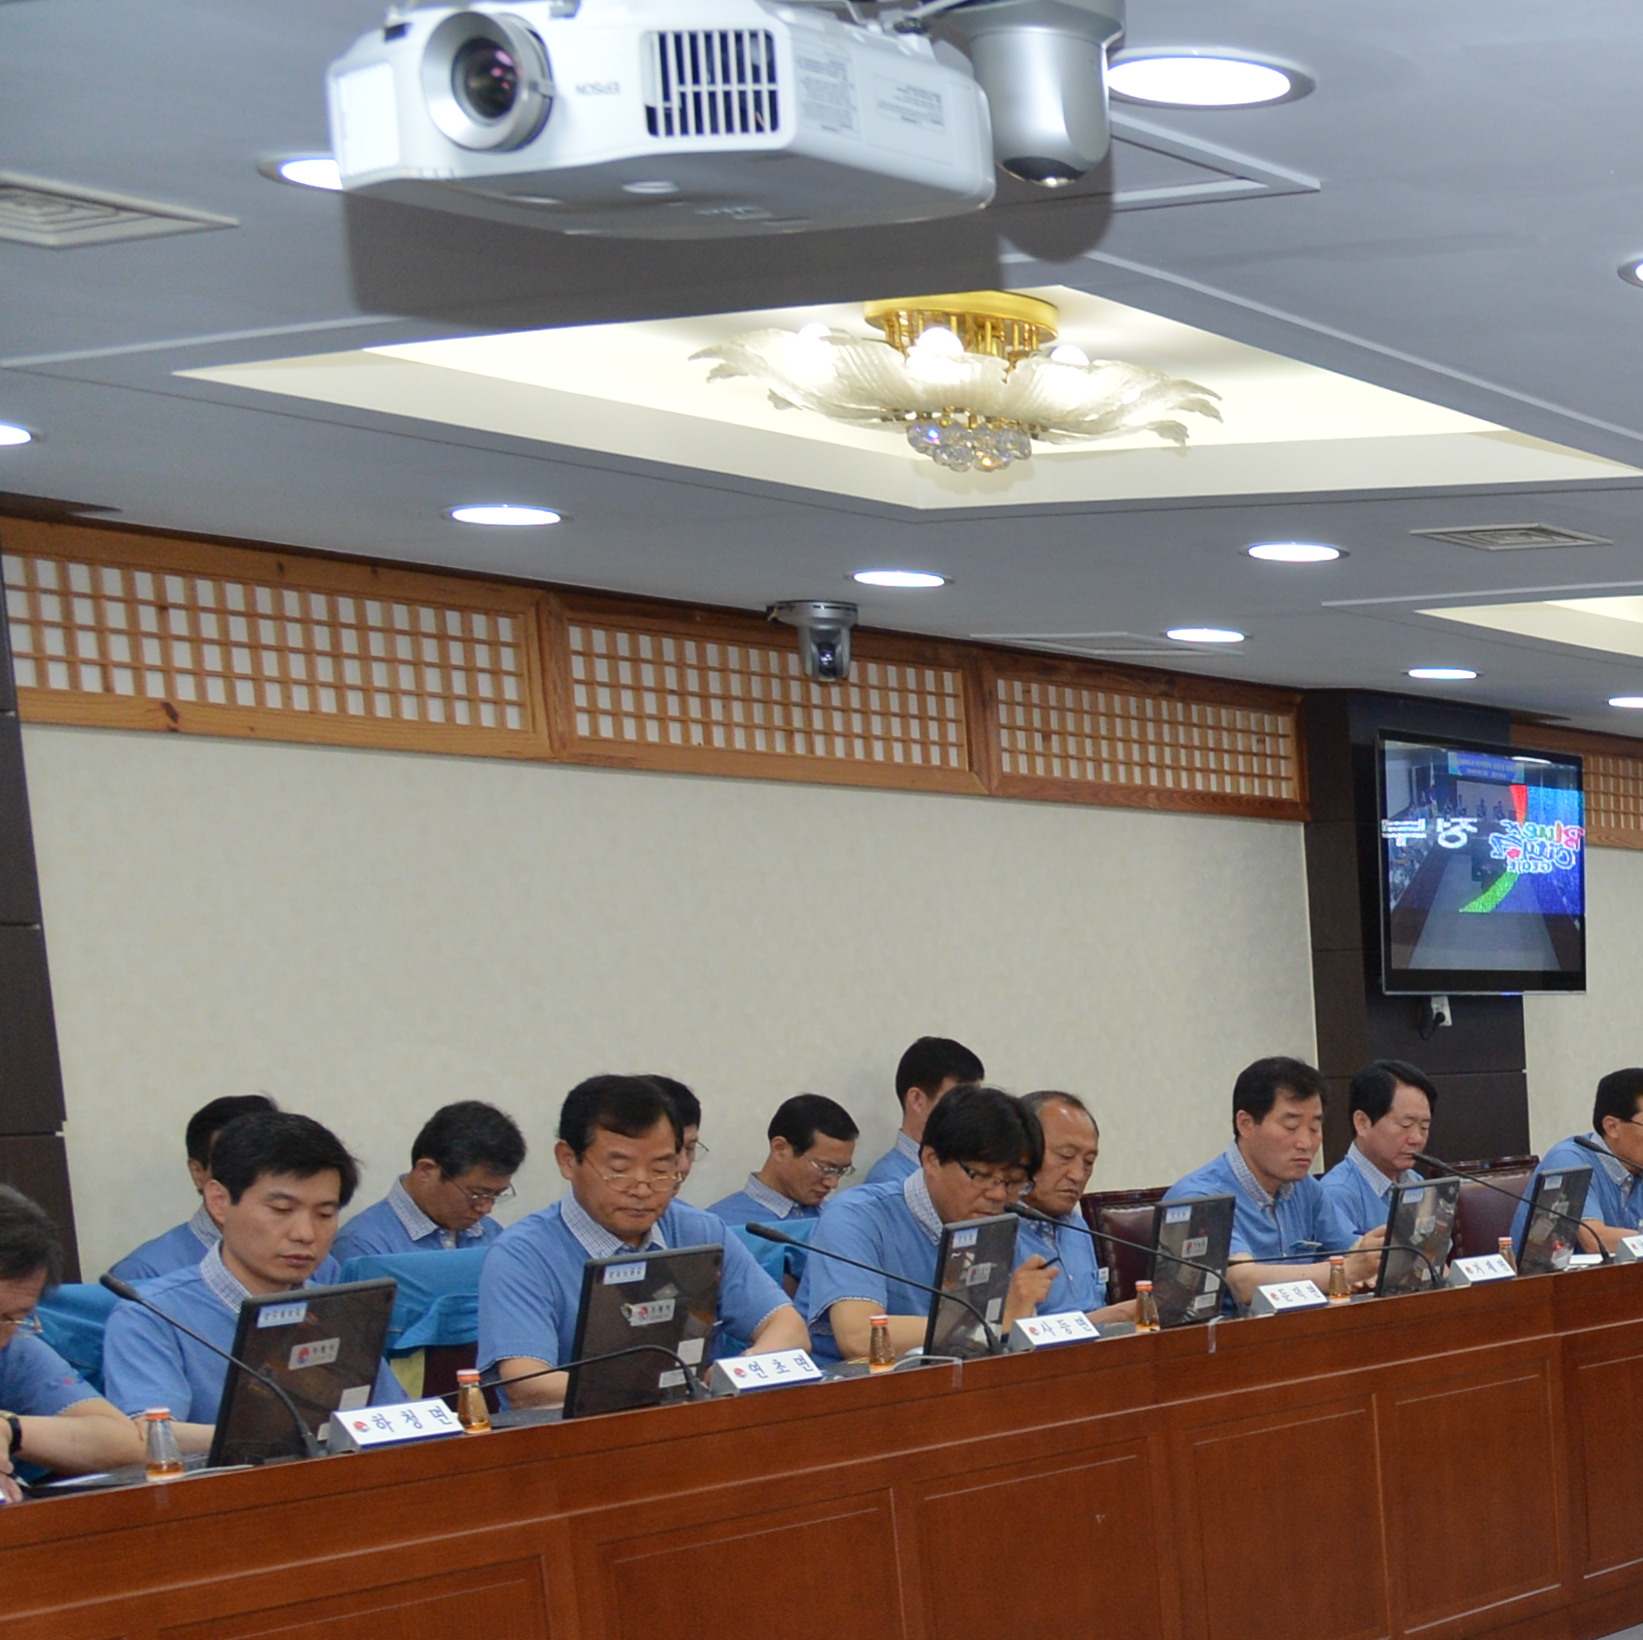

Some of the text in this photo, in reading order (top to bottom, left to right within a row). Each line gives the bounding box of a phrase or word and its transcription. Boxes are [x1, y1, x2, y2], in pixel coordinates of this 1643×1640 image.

[1041, 1316, 1092, 1337] 사등면
[749, 1354, 813, 1379] 연초면
[371, 1405, 453, 1433] 하청면
